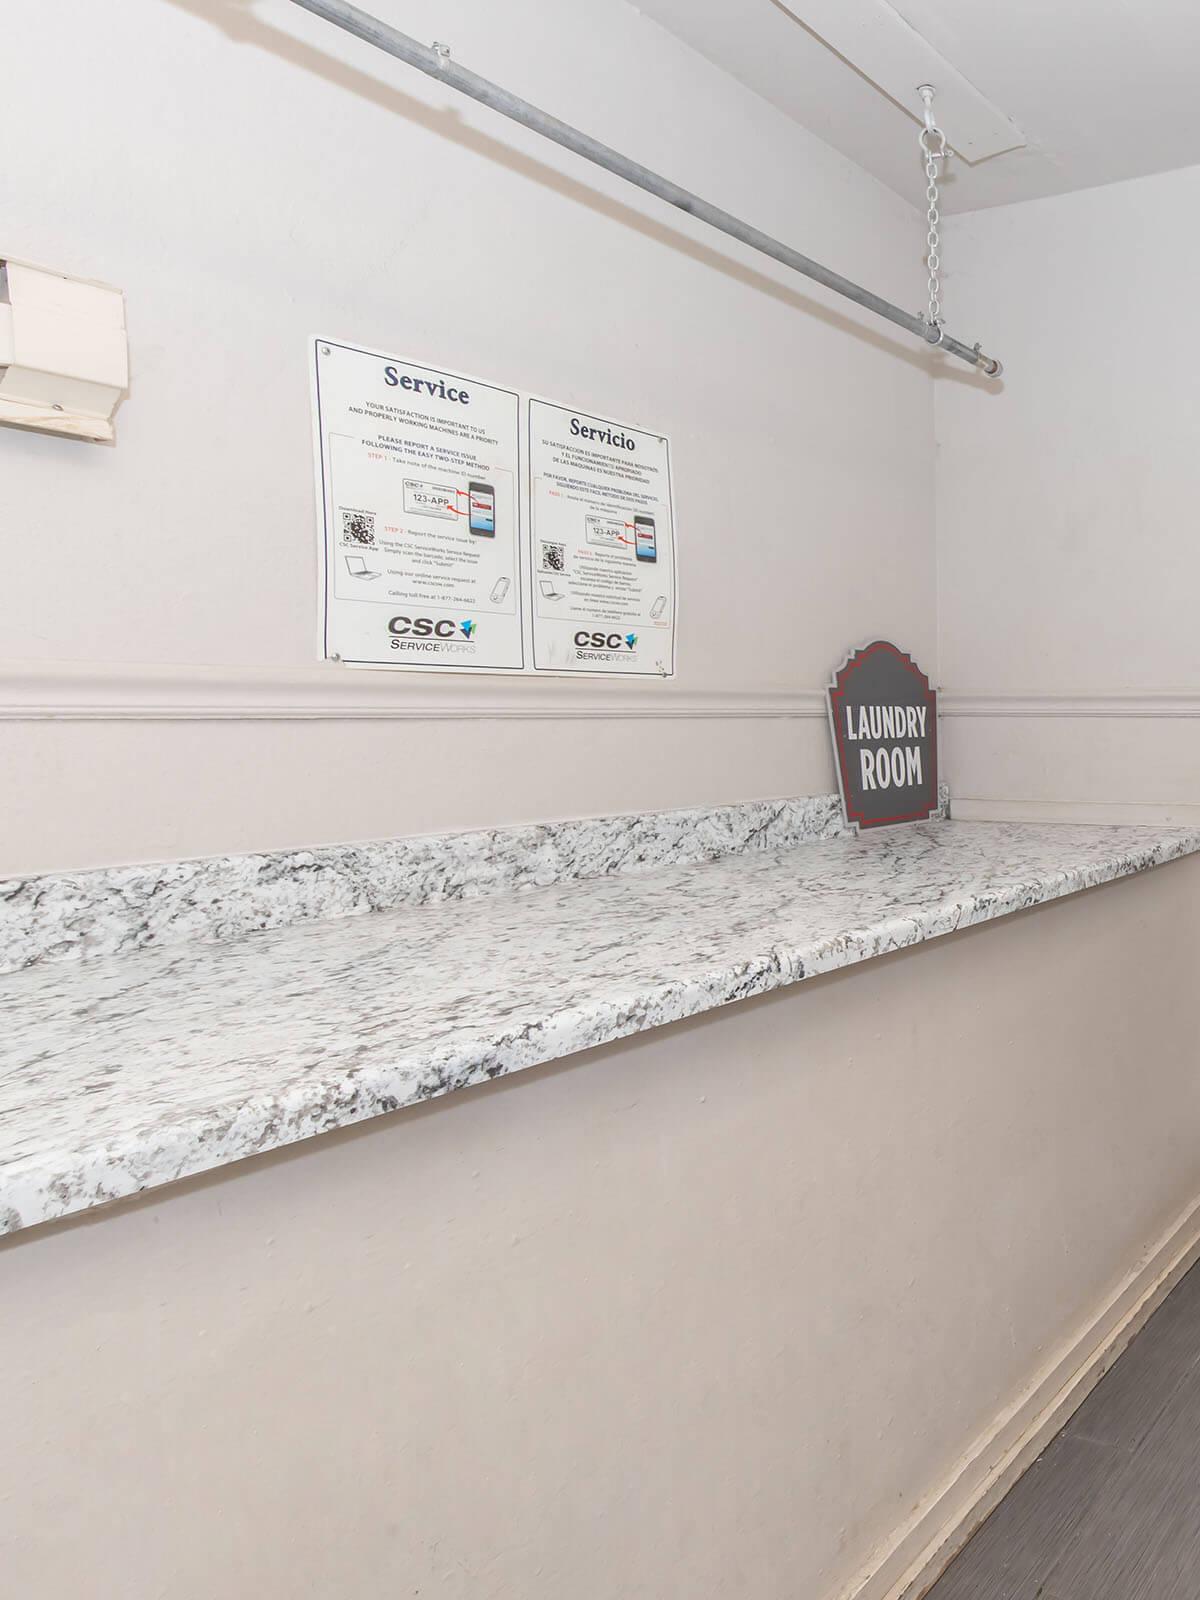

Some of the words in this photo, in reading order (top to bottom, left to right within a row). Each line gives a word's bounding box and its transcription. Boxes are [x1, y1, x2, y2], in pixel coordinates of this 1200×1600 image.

[384, 366, 470, 404] Service
[349, 406, 363, 415] AND
[365, 410, 397, 422] PROPERLY
[399, 417, 428, 429] WORKING
[429, 425, 458, 437] MACHINES
[476, 436, 498, 445] PRIORITY
[366, 401, 384, 411] YOUR
[385, 406, 431, 422] SATISFACTION
[437, 418, 469, 430] IMPORTANT
[378, 435, 402, 446] PLEASE
[404, 440, 428, 451] REPORT
[436, 447, 459, 457] SERVICE
[570, 418, 635, 451] Servicio
[362, 440, 402, 453] FOLLOWING
[404, 448, 416, 456] THE
[418, 450, 433, 459] EASY
[466, 461, 490, 471] METHOD
[368, 452, 383, 460] STEP
[413, 493, 449, 506] 123-APP
[384, 526, 399, 534] STEP
[388, 616, 456, 637] CSC
[574, 631, 622, 649] CSC
[846, 705, 927, 740] LAUNDRY
[860, 746, 923, 790] ROOM
